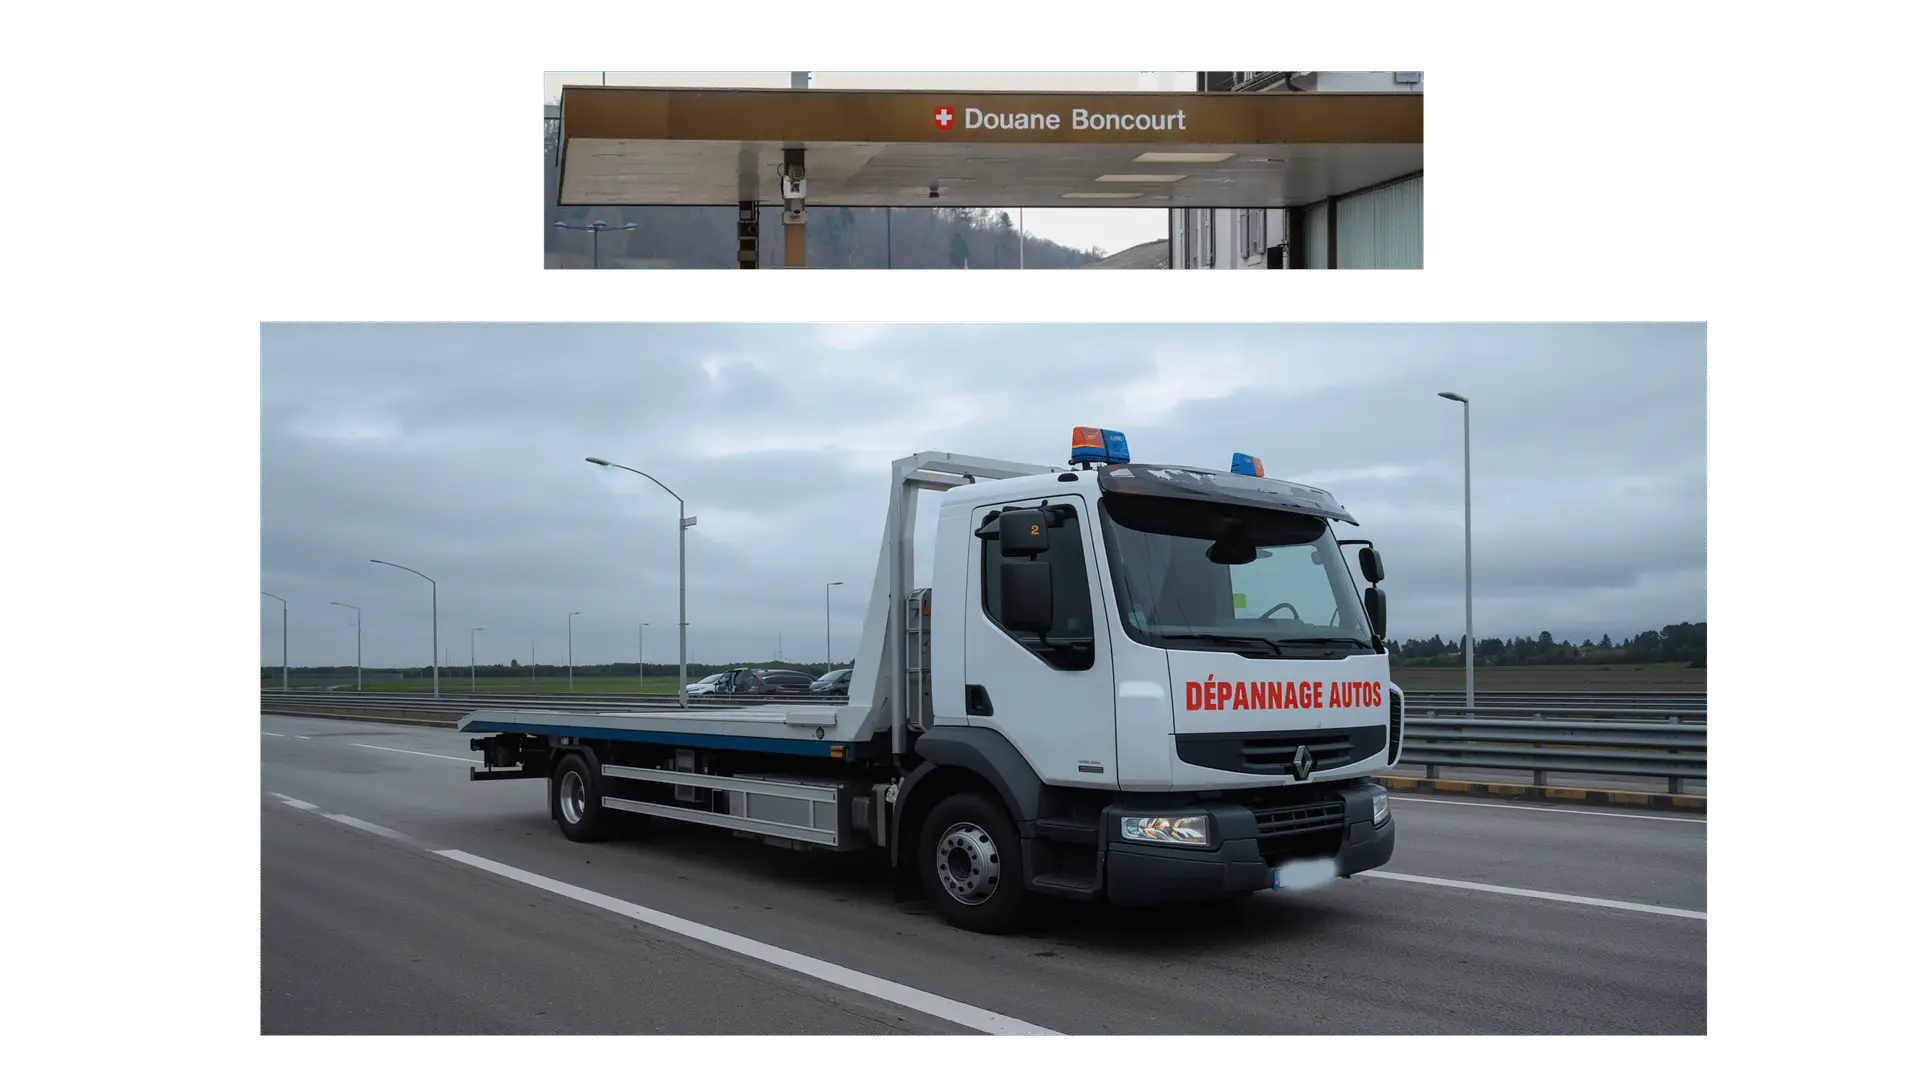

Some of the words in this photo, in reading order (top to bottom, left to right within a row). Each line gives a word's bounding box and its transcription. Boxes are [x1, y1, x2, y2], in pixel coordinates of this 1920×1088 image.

[965, 108, 1060, 130] Douane
[1072, 109, 1186, 131] Boncourt
[1031, 524, 1040, 535] 2
[1186, 674, 1323, 711] DÉPANNAGE
[1329, 681, 1382, 709] AUTOS
